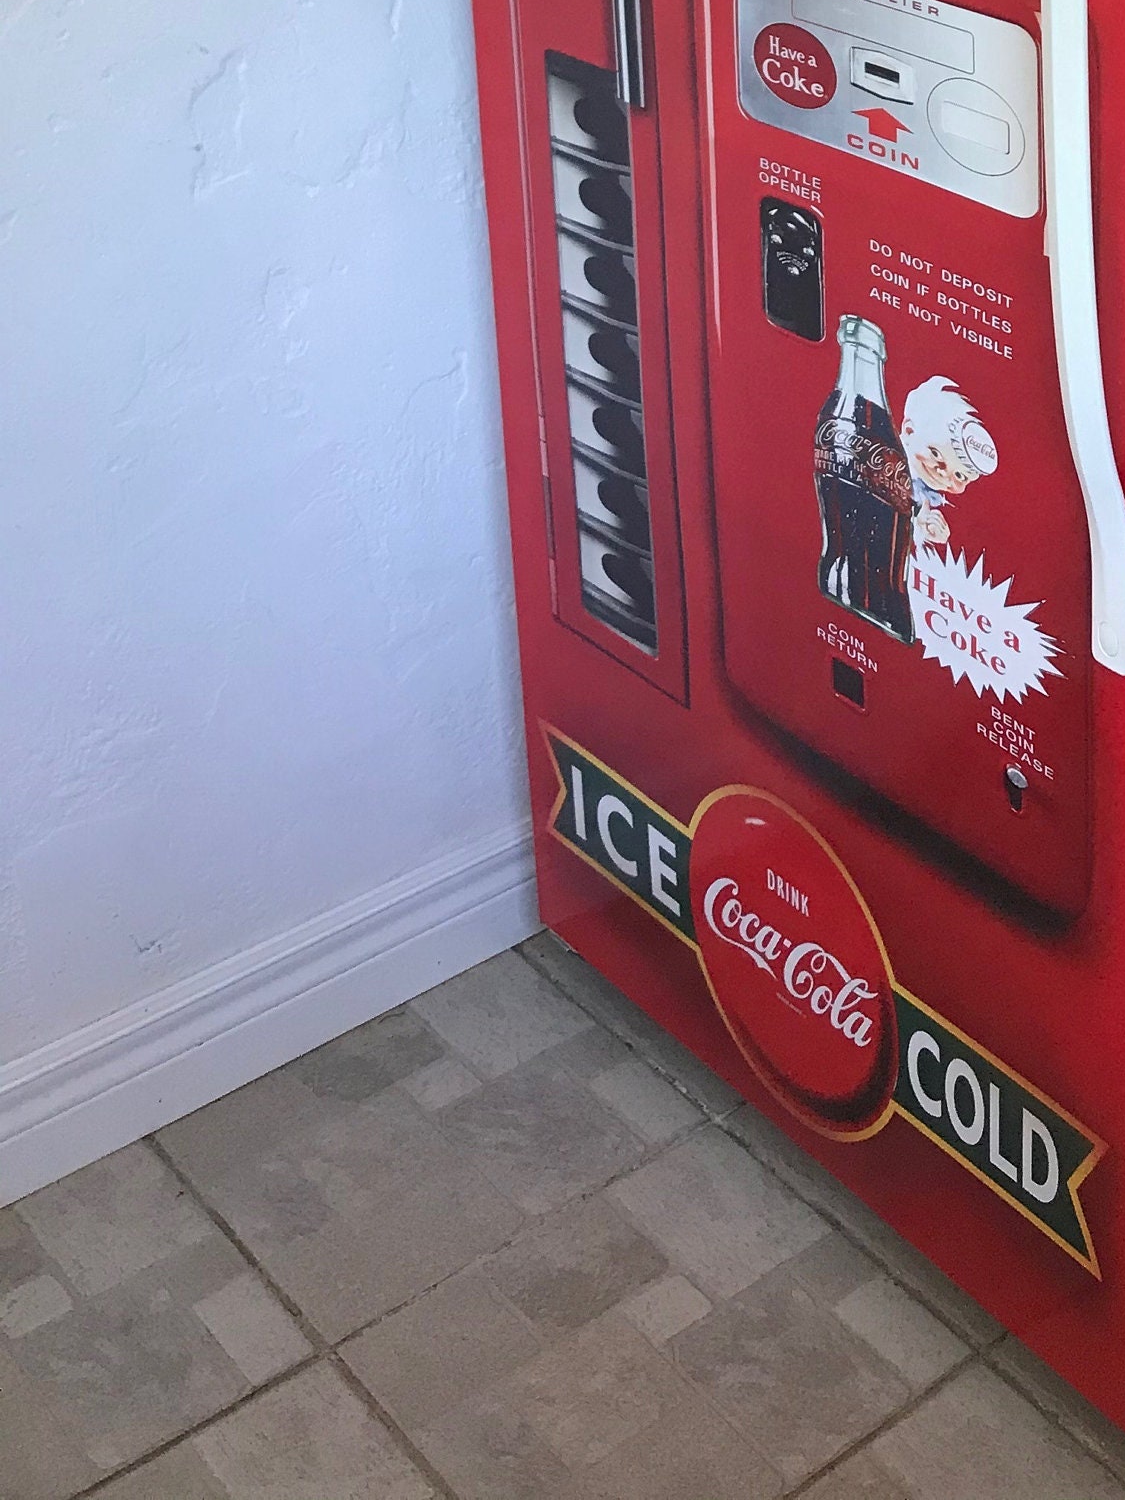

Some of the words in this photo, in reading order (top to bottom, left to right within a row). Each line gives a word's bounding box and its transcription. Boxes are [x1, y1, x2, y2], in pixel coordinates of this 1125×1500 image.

[769, 35, 805, 63] Have
[807, 55, 818, 68] a
[762, 58, 824, 97] Coke
[759, 158, 821, 188] BOTTLE
[847, 134, 919, 170] COIN
[758, 172, 822, 203] OPENER
[869, 239, 893, 257] DO
[900, 251, 933, 275] NOT
[941, 269, 1013, 309] DEPOSIT
[870, 264, 909, 290] COIN
[917, 283, 930, 297] IF
[938, 291, 1012, 334] BOTTLES
[869, 287, 901, 309] ARE
[909, 303, 942, 326] NOT
[949, 321, 1013, 360] VISIBLE
[912, 567, 992, 633] Have
[1003, 628, 1021, 653] a
[817, 627, 878, 673] RETURN
[828, 622, 864, 651] COIN
[924, 610, 1006, 675] Coke
[991, 706, 1035, 741] BENT
[993, 721, 1034, 754] COIN
[976, 722, 1054, 780] RELEASE
[571, 765, 680, 917] ICE
[766, 867, 810, 917] DRINK
[704, 877, 878, 1047] Coca-Cola
[907, 1030, 1059, 1203] COLD
